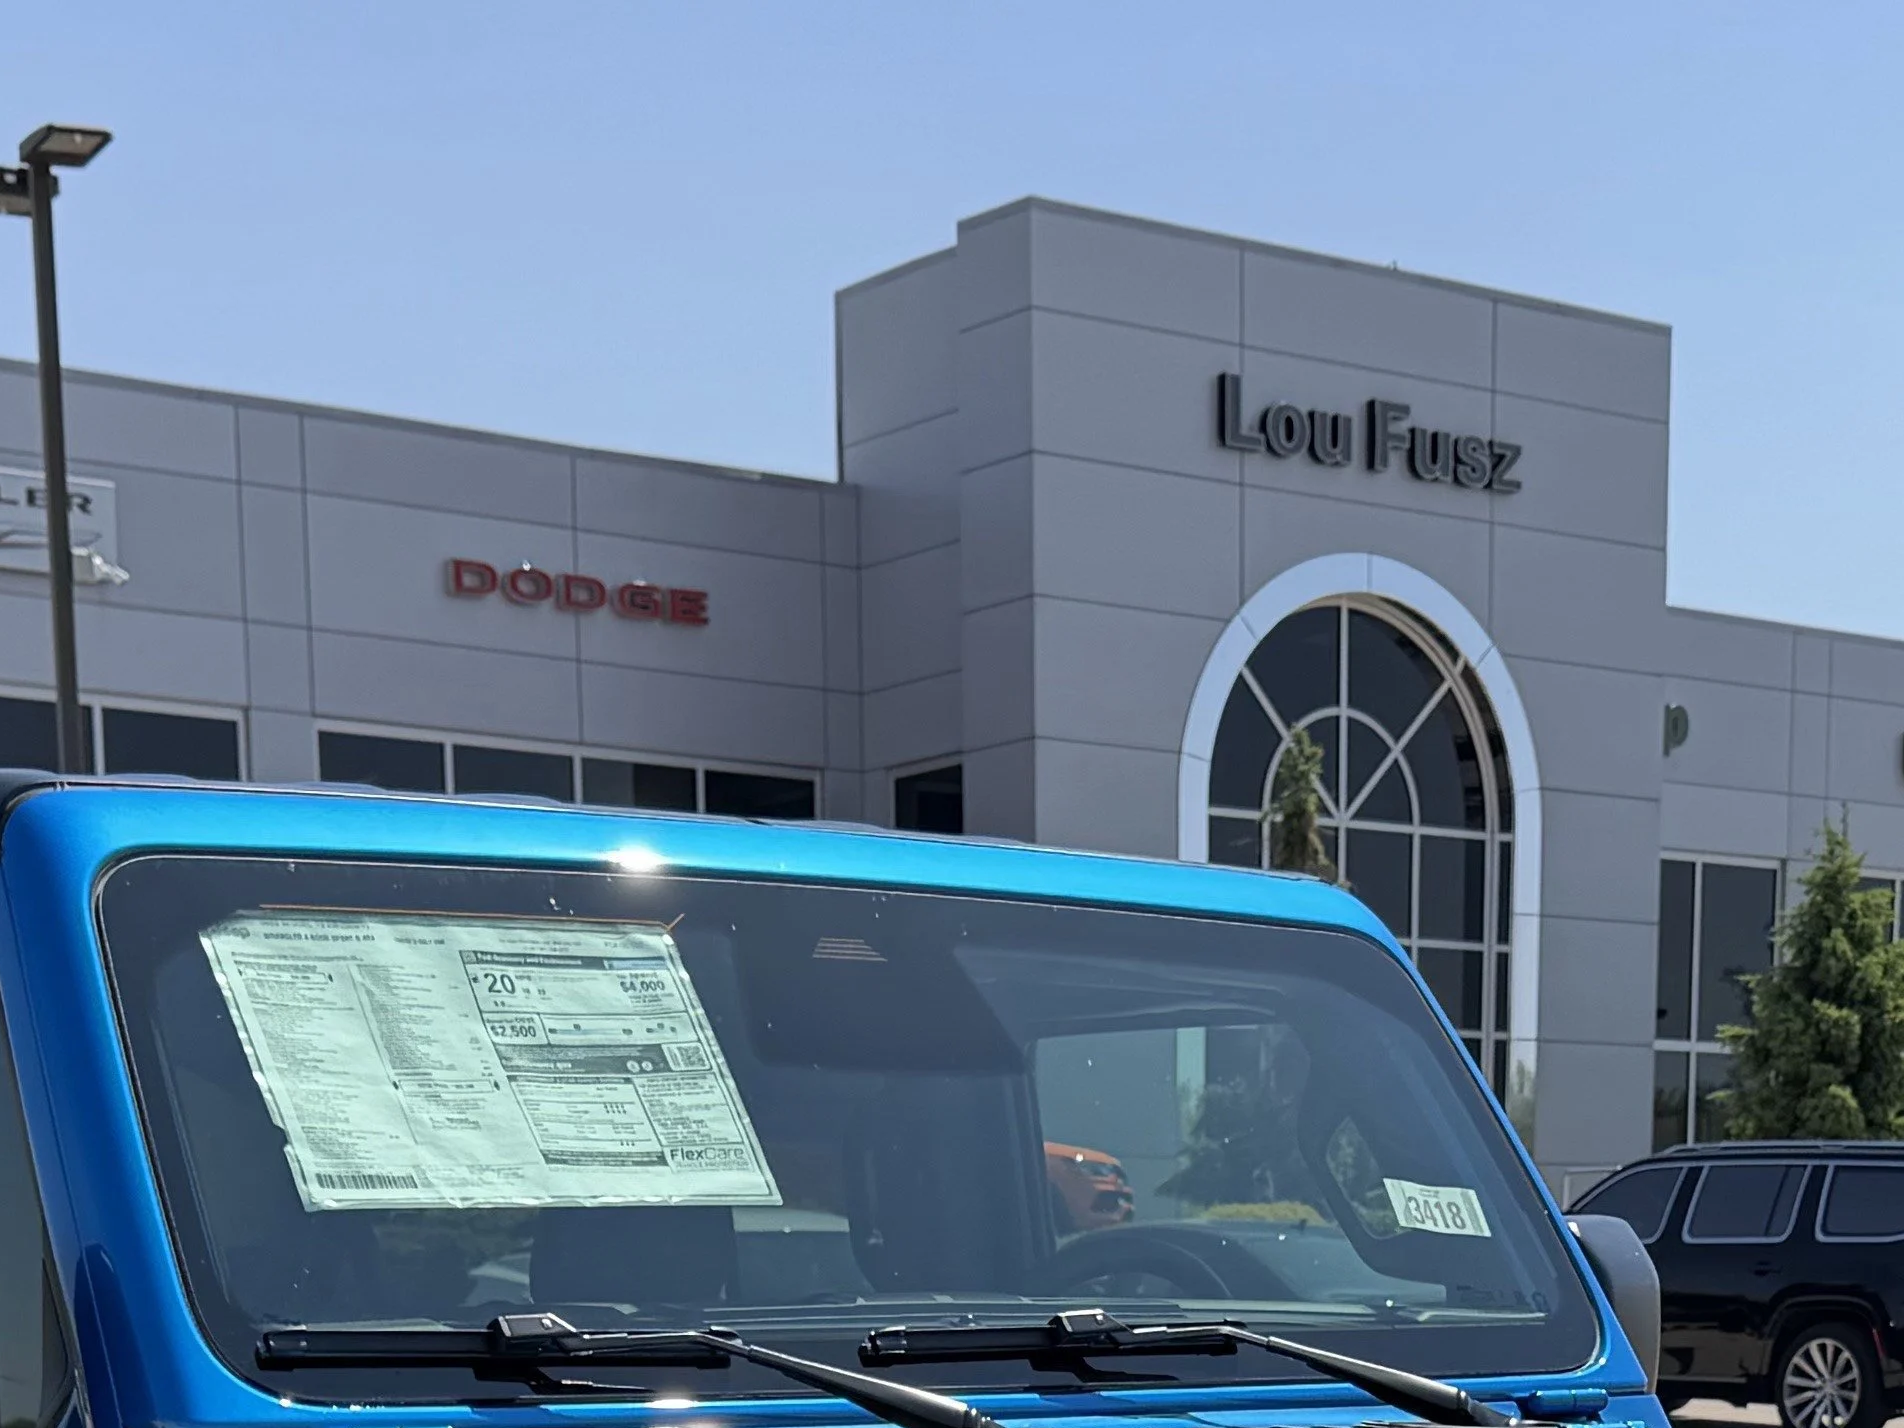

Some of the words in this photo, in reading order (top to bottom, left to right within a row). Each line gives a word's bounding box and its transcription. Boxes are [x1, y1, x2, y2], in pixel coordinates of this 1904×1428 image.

[1216, 371, 1353, 467] Lou
[1366, 397, 1524, 494] Fusz
[446, 557, 709, 627] DODGE
[483, 972, 516, 996] 20
[669, 1146, 744, 1163] FlexCare
[1407, 1196, 1467, 1231] 3418
